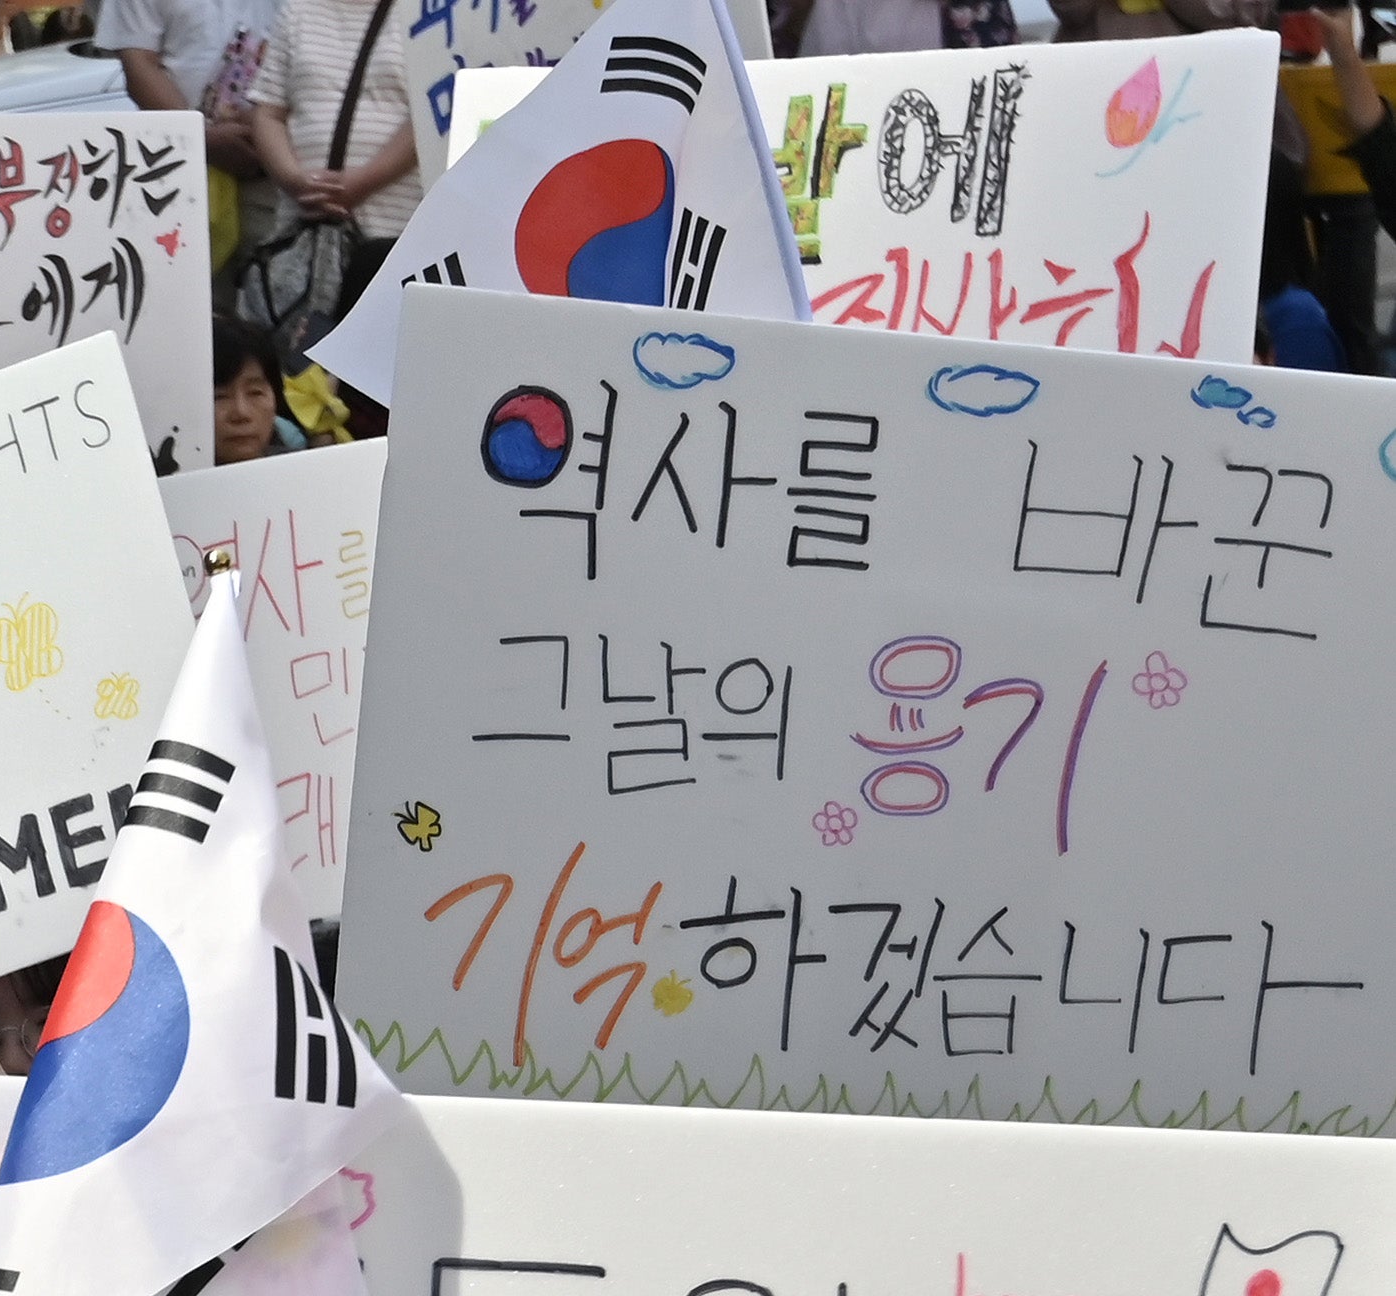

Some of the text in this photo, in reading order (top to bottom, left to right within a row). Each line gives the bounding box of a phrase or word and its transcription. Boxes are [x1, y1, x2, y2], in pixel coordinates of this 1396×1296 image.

[481, 380, 1334, 641] 역사를 바꾼
[472, 634, 1108, 857] 그날의 용기
[424, 841, 1364, 1068] 기억하겠습니다
